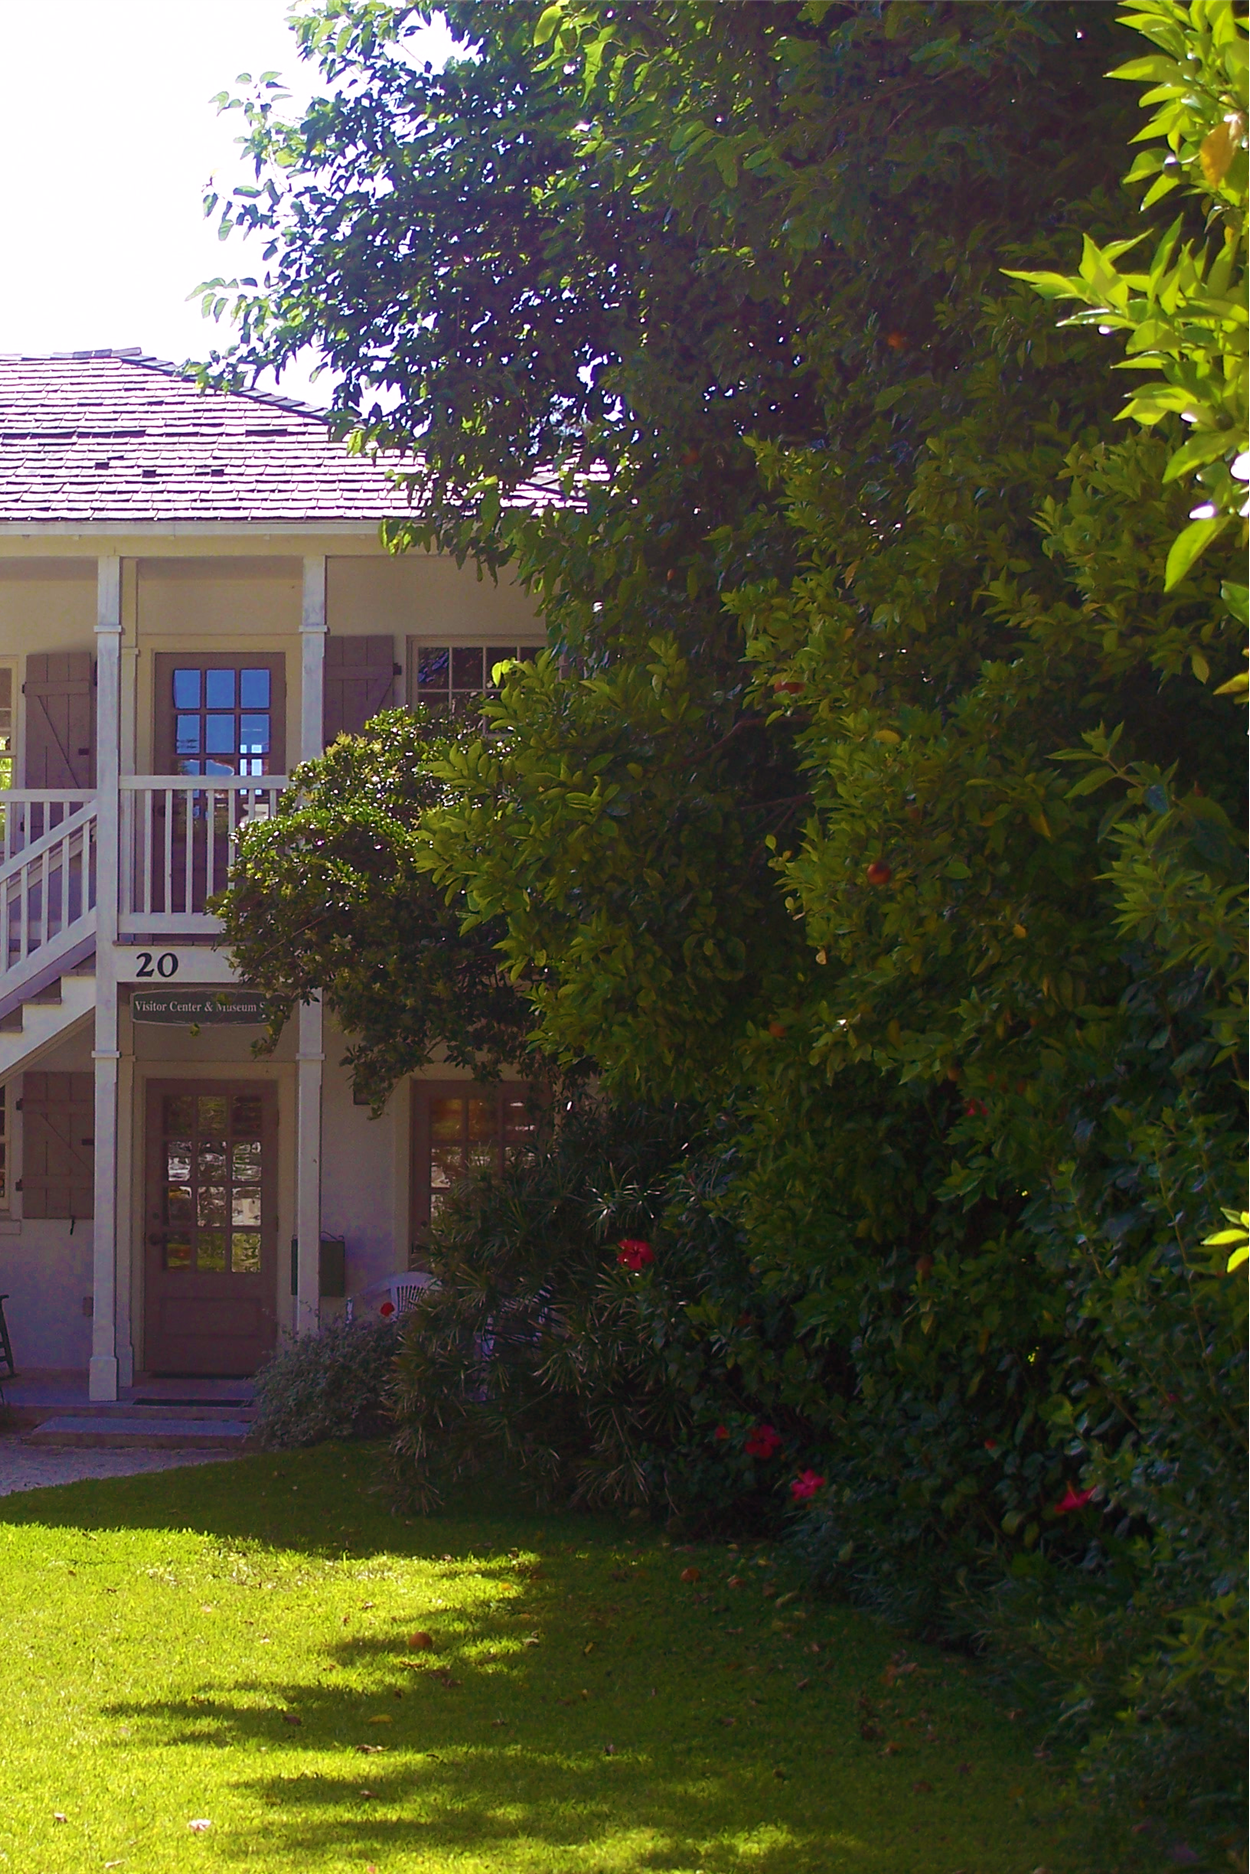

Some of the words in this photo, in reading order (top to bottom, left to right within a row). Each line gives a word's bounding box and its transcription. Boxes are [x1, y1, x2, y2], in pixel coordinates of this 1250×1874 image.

[136, 952, 179, 978] 20
[135, 1000, 167, 1012] Visitor
[170, 1001, 202, 1012] Center
[204, 1001, 213, 1012] &
[216, 1001, 257, 1012] Museum
